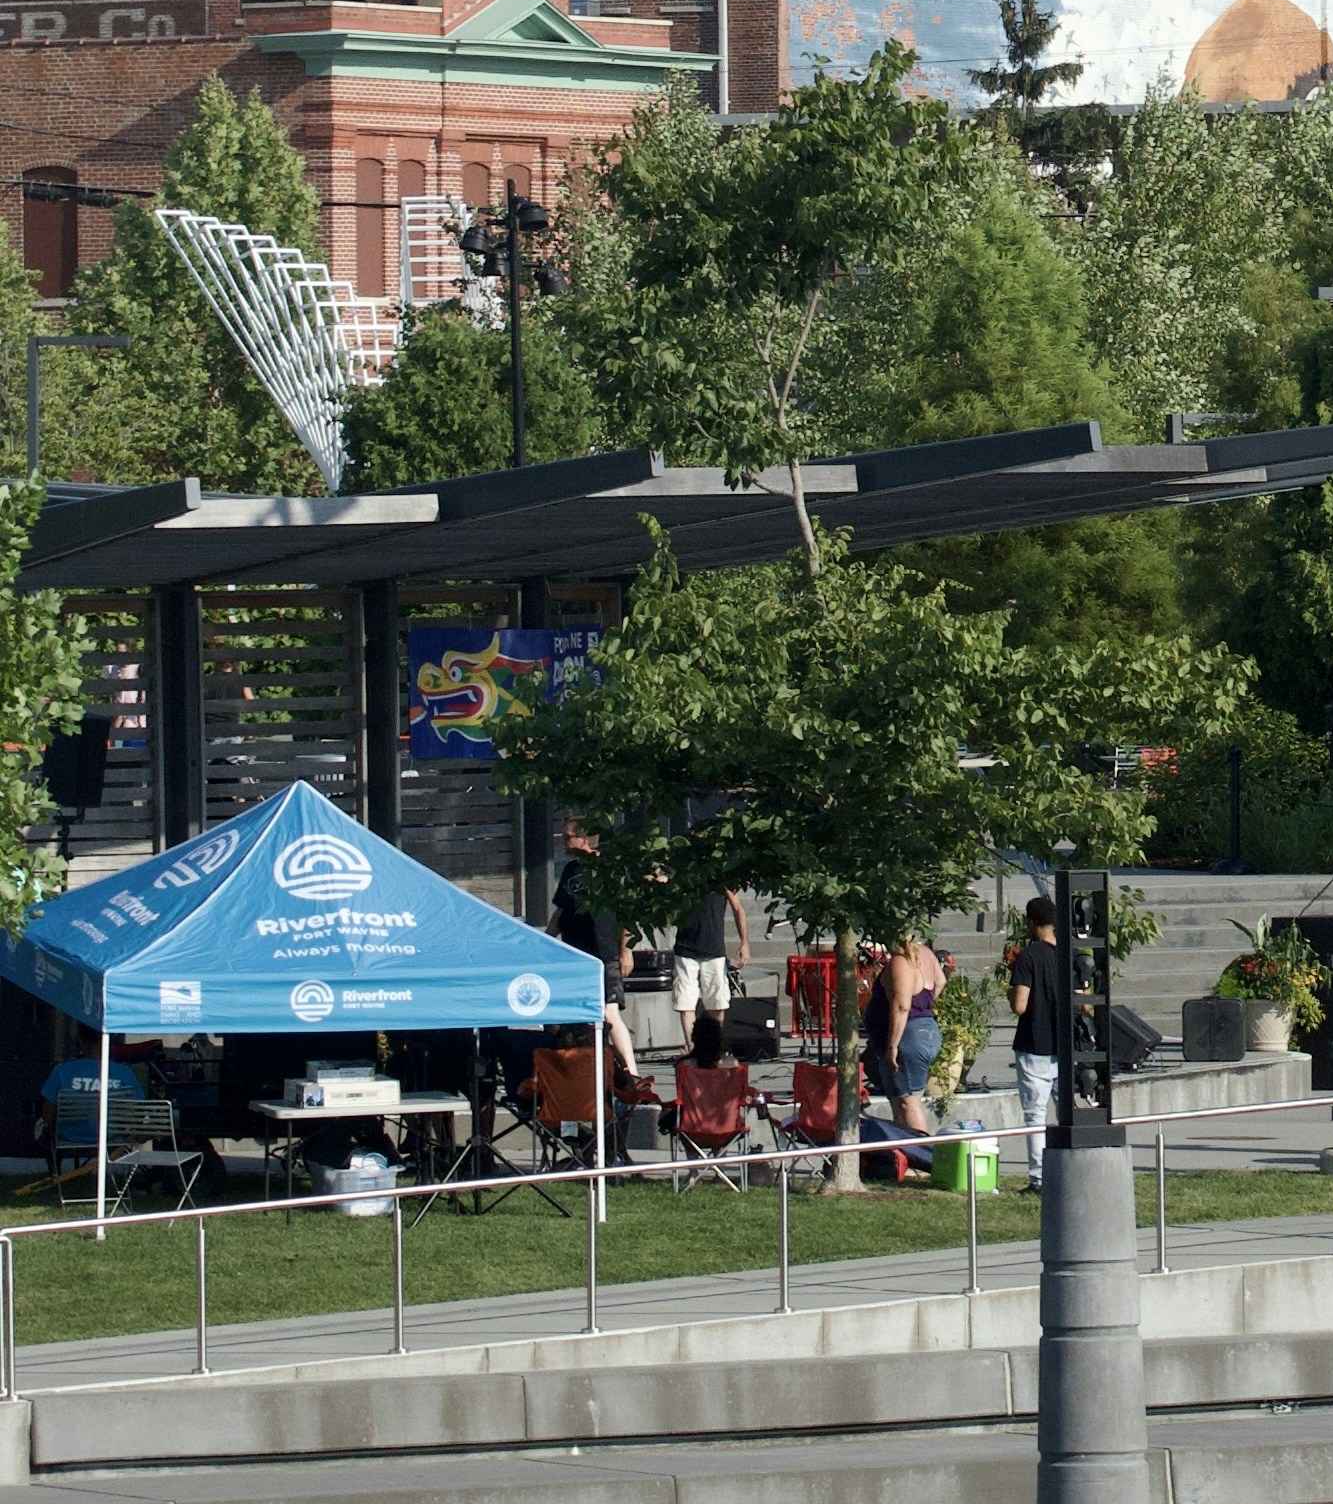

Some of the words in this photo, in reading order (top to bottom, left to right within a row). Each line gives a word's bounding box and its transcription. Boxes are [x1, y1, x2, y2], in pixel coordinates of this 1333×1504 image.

[256, 907, 417, 936] Riverfront
[293, 928, 332, 942] FORT
[337, 927, 390, 937] WAYNE
[273, 944, 340, 959] Always
[346, 943, 422, 955] moving.
[342, 989, 413, 1002] Riverfront
